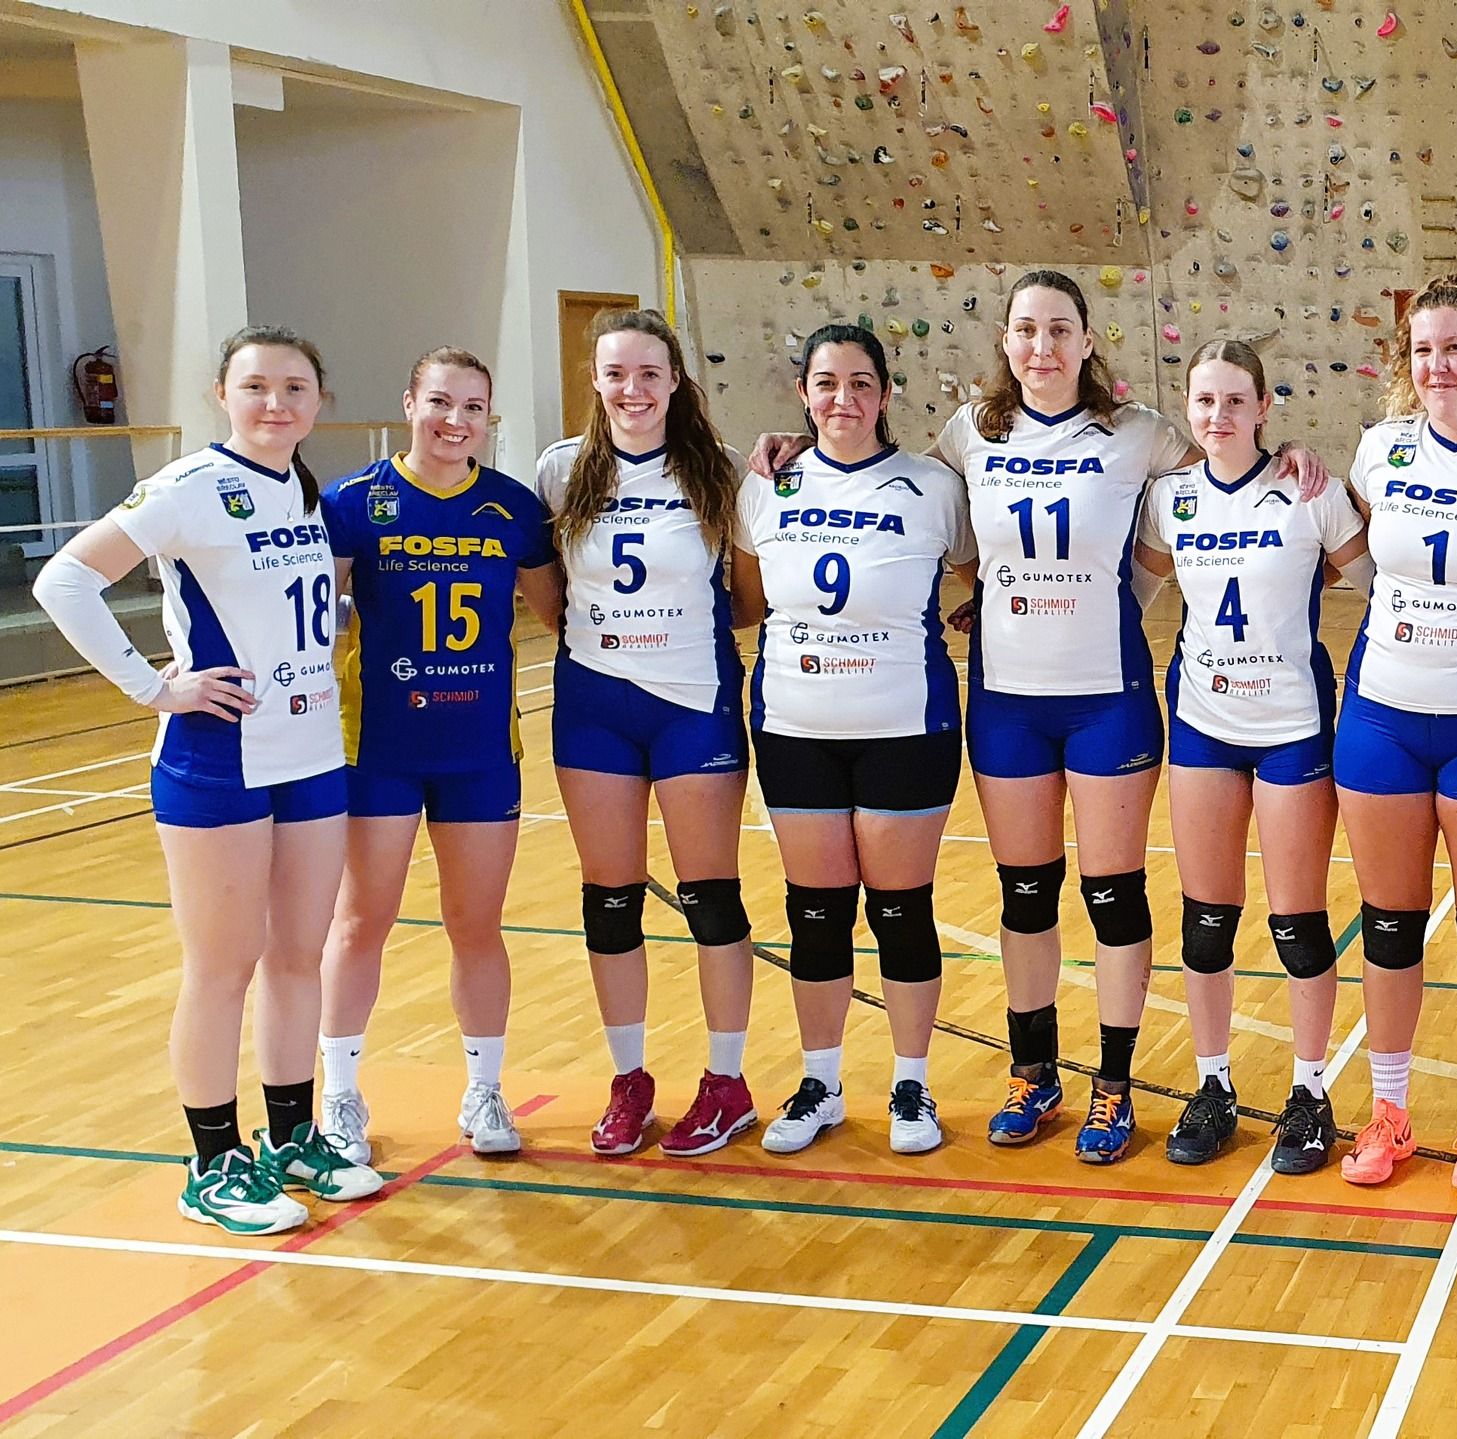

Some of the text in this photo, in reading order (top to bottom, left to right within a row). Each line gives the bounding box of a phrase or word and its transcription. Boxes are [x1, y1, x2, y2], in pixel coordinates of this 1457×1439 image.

[984, 456, 1105, 475] FOSFA
[980, 476, 1063, 489] Life Science
[600, 497, 693, 513] OSFA
[1379, 502, 1399, 512] Life
[779, 508, 905, 536] FOSFA
[1007, 496, 1070, 561] 11
[245, 524, 328, 553] FOSF
[800, 532, 860, 545] Science
[1176, 530, 1284, 551] FOSFA
[379, 535, 507, 558] FOSFA
[252, 552, 324, 571] Life Science
[612, 532, 647, 594] 5
[1176, 556, 1245, 567] Life Science
[1422, 530, 1450, 586] 1
[378, 560, 469, 572] Life Science
[813, 552, 850, 616] 9
[1022, 573, 1092, 583] GUMOTEX
[1030, 598, 1077, 609] SCHMIDT
[1215, 576, 1249, 642] 4
[284, 573, 331, 652] 18
[410, 581, 483, 652] 15
[612, 608, 683, 619] GUMOTEX
[622, 634, 669, 644] SCHMIDT
[816, 631, 889, 643] GUMOTEX
[823, 657, 877, 668] SCHMIDT
[1217, 654, 1284, 666] GUMOTEX
[301, 663, 331, 676] GUMO
[425, 664, 495, 675] GUMOTEX
[823, 667, 874, 675] REALITY
[1231, 678, 1271, 689] SCHMIDT
[433, 691, 479, 704] SCHMIDT
